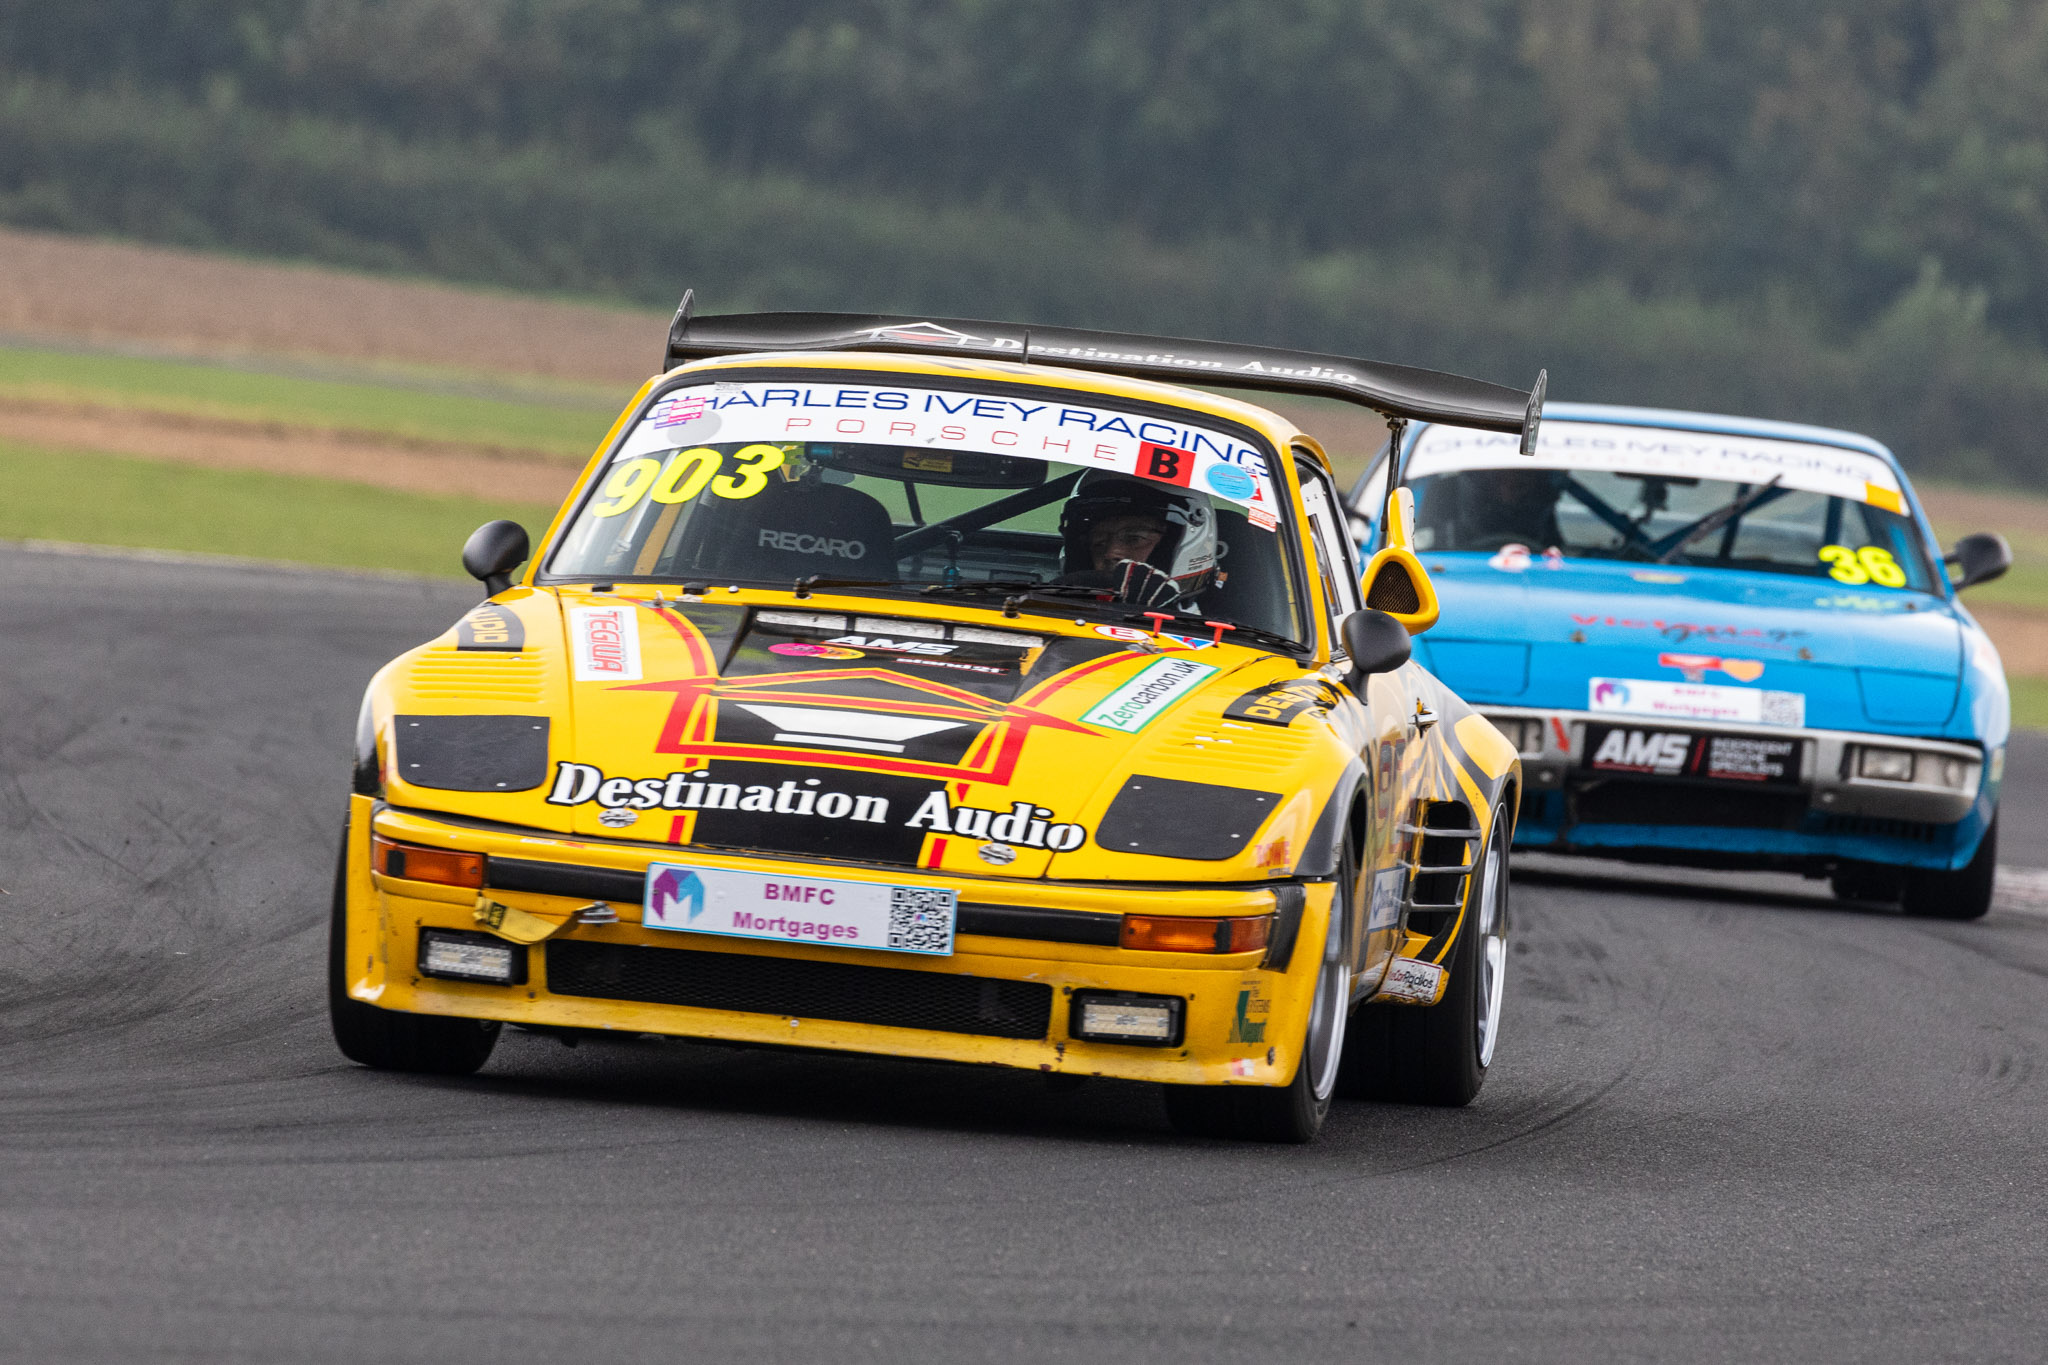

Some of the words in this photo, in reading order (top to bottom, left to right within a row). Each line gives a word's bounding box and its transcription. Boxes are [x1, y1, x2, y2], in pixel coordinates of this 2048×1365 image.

[991, 336, 1223, 369] Destination
[1237, 360, 1358, 383] Audio
[924, 394, 1048, 422] IVEY
[785, 417, 1119, 462] PORSCHE
[592, 444, 786, 518] 903
[1147, 446, 1181, 480] B
[757, 528, 867, 560] RECARO
[1818, 545, 1907, 588] 36
[822, 635, 960, 656] AMS
[1098, 661, 1201, 727] Zerocarbon.uk
[1593, 728, 1692, 768] AMS
[546, 761, 890, 824] Destination
[904, 789, 1087, 853] Audio
[764, 882, 835, 906] BMFC
[732, 911, 859, 941] Mortgages
